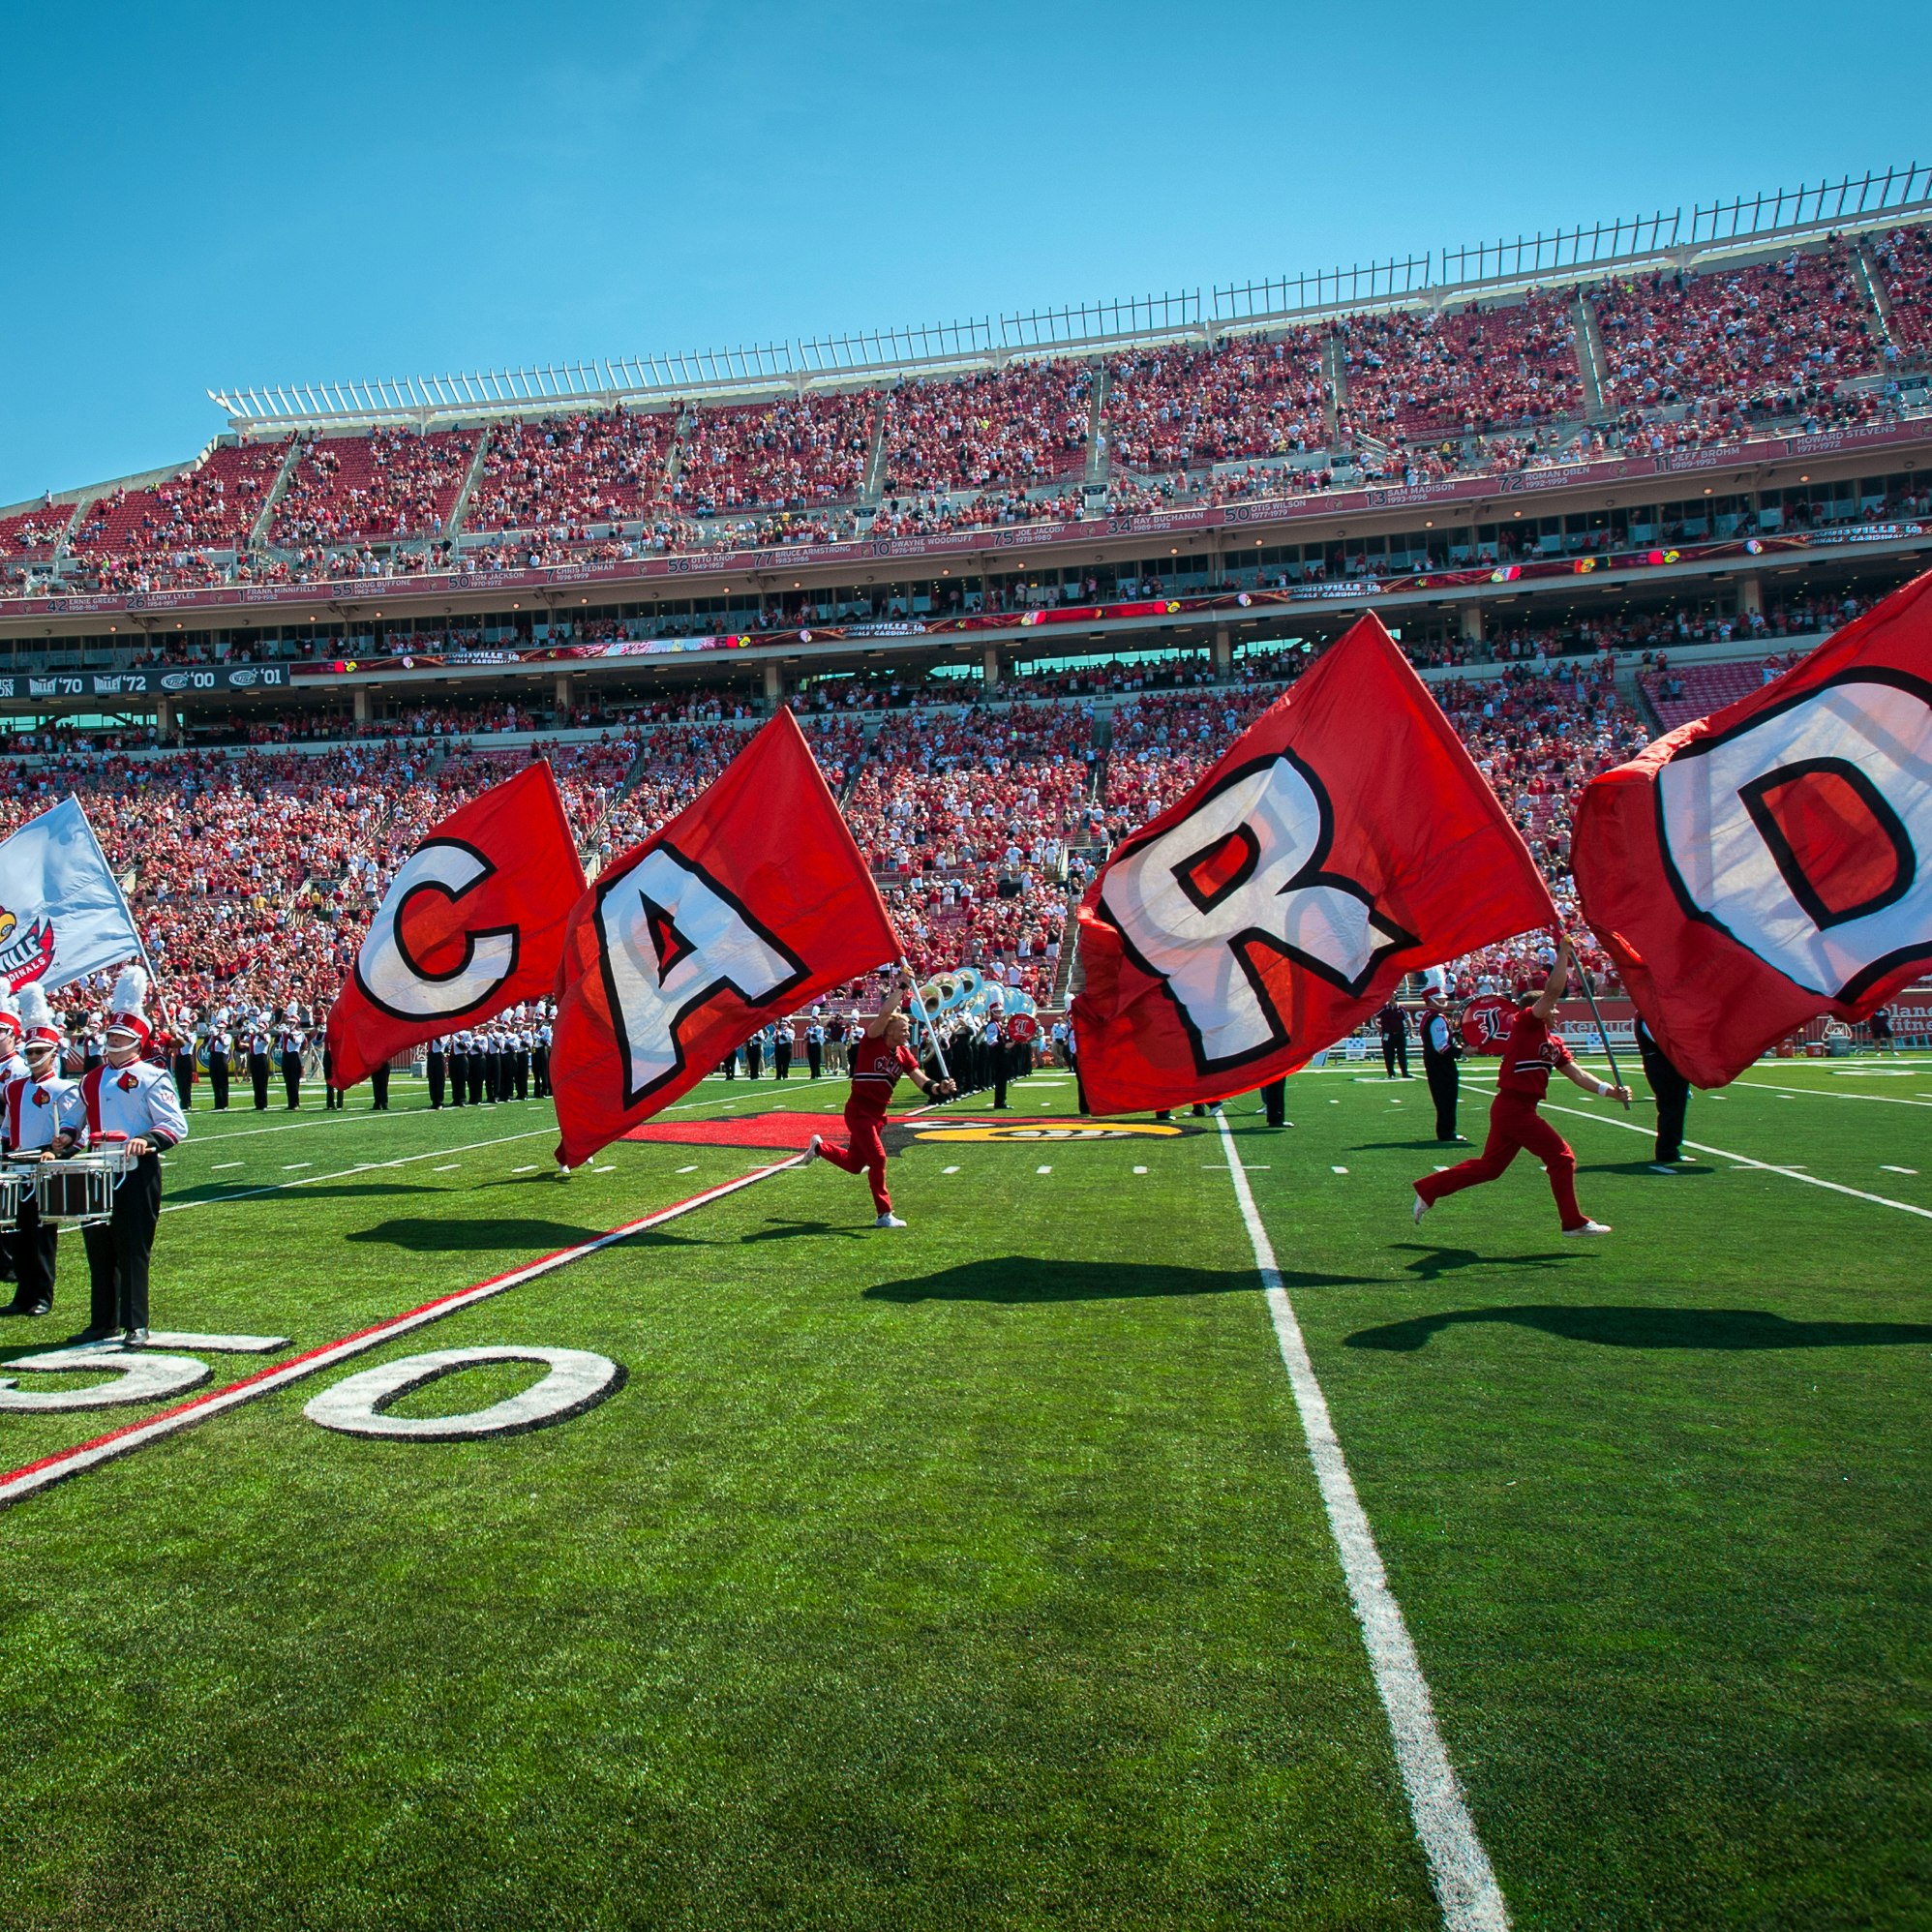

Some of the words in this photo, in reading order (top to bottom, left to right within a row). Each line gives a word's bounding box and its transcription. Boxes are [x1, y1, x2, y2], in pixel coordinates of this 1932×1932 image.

[1796, 432, 1843, 445] HOWARD
[1846, 425, 1897, 438] STEVENS
[1672, 452, 1697, 462] JEFF
[1701, 446, 1740, 459] BROHM
[1783, 438, 1794, 456] 1
[1797, 441, 1841, 453] 1971-1972
[1653, 455, 1671, 473] 11
[1525, 470, 1559, 480] ROMAN
[1563, 467, 1590, 475] OBEN
[1387, 488, 1407, 498] SAM
[1410, 483, 1455, 495] MADISON
[1496, 475, 1524, 493] 72
[1251, 503, 1270, 512] OTIS
[1272, 499, 1307, 509] WILSON
[1365, 491, 1386, 506] 13
[1154, 512, 1204, 523] BUCHANAN
[1223, 506, 1251, 523] 50
[1034, 526, 1066, 534] JACOBY
[1106, 518, 1132, 534] 34
[891, 539, 925, 548] DWAYNE
[927, 535, 974, 545] WOODRUFF
[991, 531, 1014, 546] 75
[802, 545, 851, 555] ARMSTRONG
[871, 542, 890, 557] 10
[668, 558, 689, 573] 56
[752, 553, 773, 567] 77
[489, 571, 525, 580] JACKSON
[544, 568, 555, 583] 7
[557, 566, 580, 575] CHRIS
[582, 563, 615, 572] REDMAN
[274, 585, 317, 593] MINNIFIELD
[448, 575, 469, 589] 50
[238, 589, 245, 603] 1
[332, 583, 352, 597] 55
[46, 599, 68, 612] 42
[126, 596, 145, 610] 26
[30, 678, 56, 693] VALLEY
[94, 676, 122, 691] VALLEY
[1654, 665, 1932, 1004] D
[1097, 746, 1422, 1075] R
[353, 836, 520, 1022] C
[592, 840, 812, 1110] A
[1472, 1007, 1512, 1044] L
